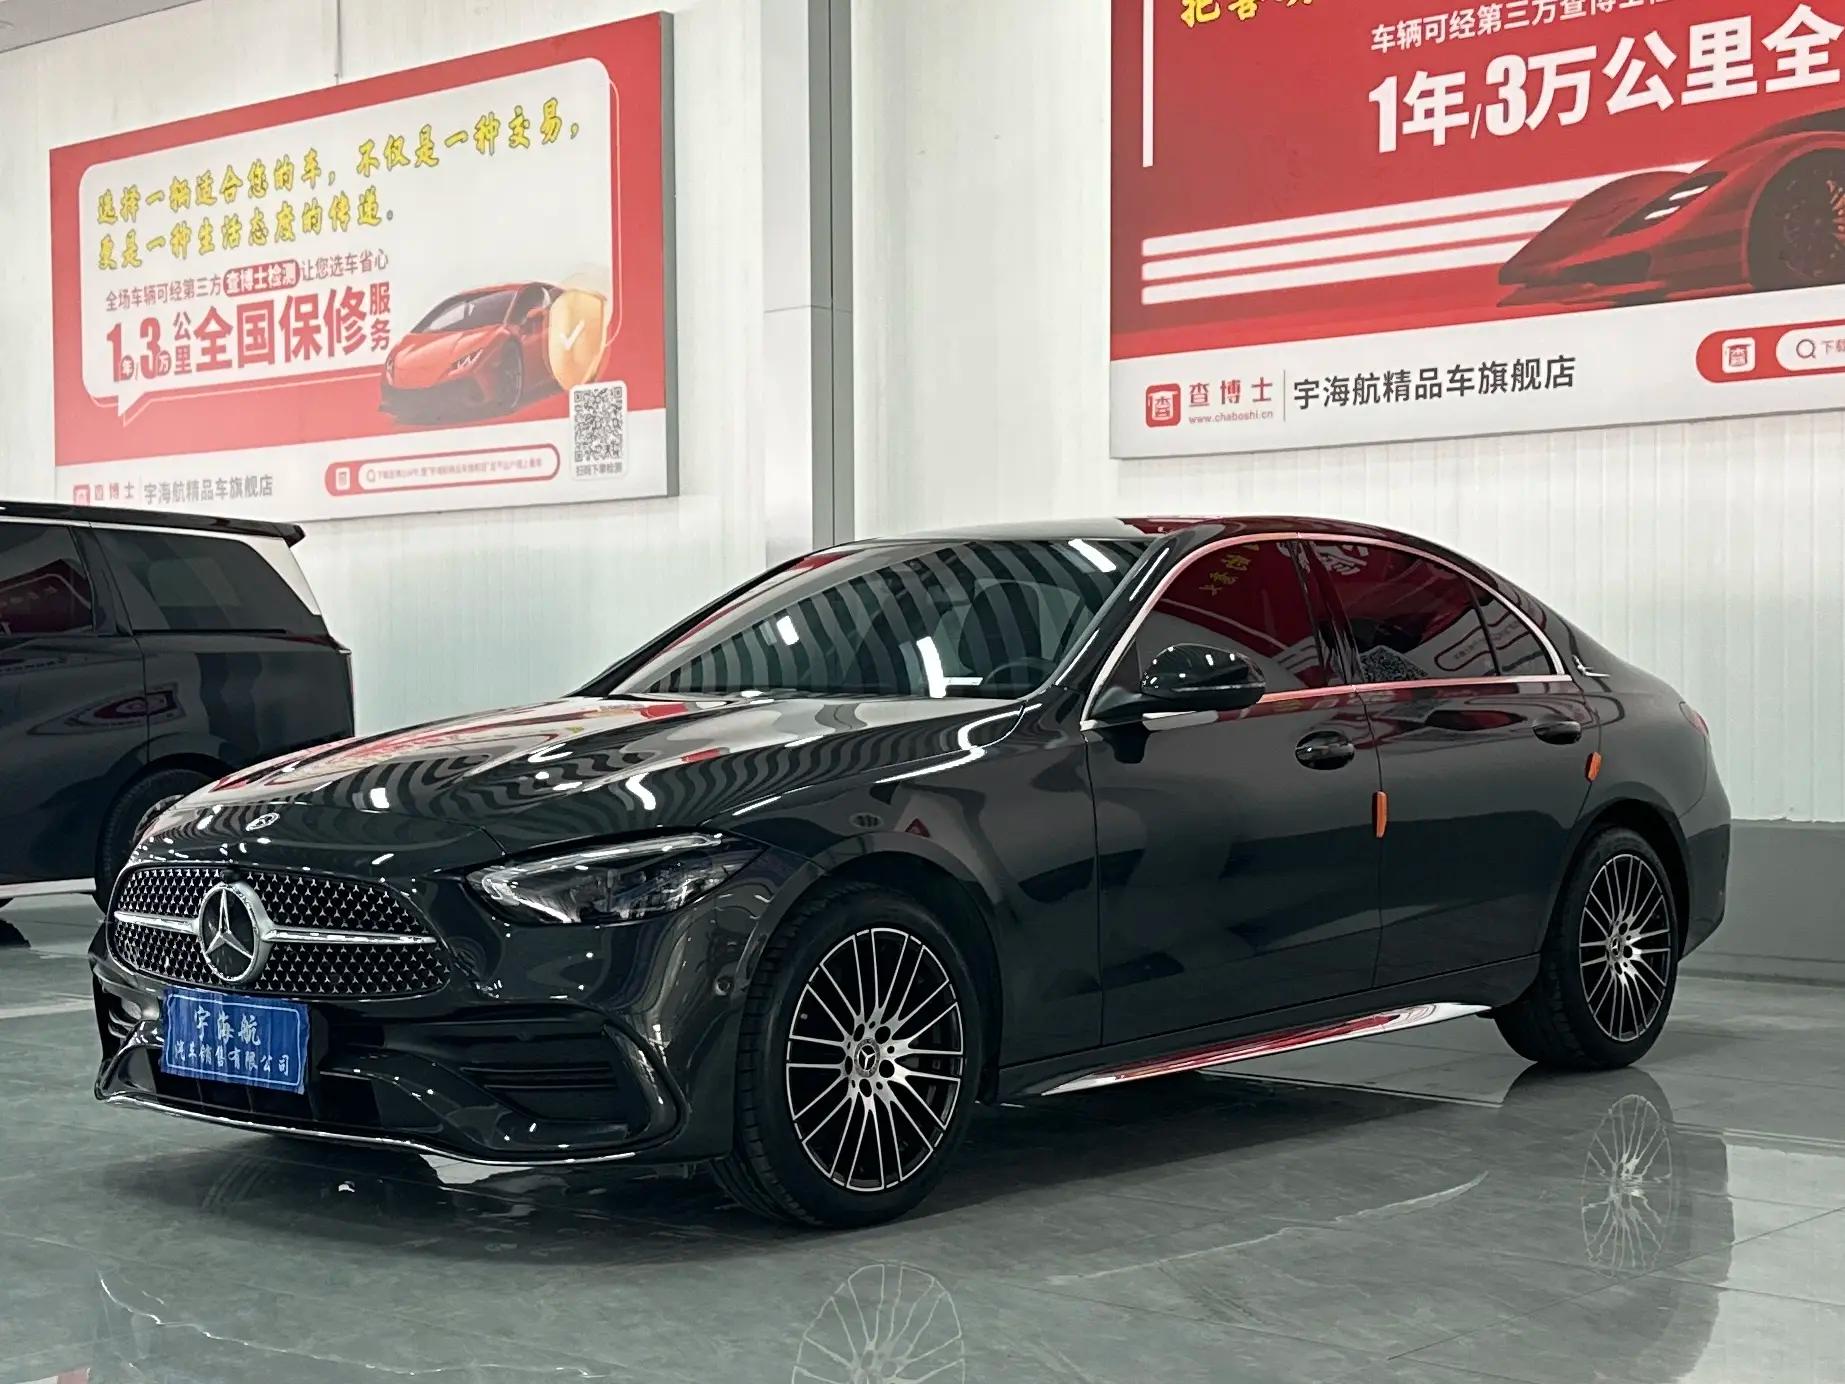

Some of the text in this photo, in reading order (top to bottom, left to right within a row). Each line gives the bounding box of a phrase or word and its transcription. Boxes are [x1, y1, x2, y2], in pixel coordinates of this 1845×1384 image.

[1189, 376, 1273, 408] 查博士
[1293, 355, 1577, 411] 宇海航精品车旗舰店
[1188, 409, 1274, 424] www.chaboshi.cn
[144, 474, 273, 504] 宇海航精品车旗舰店
[194, 1005, 261, 1046] 宇海航
